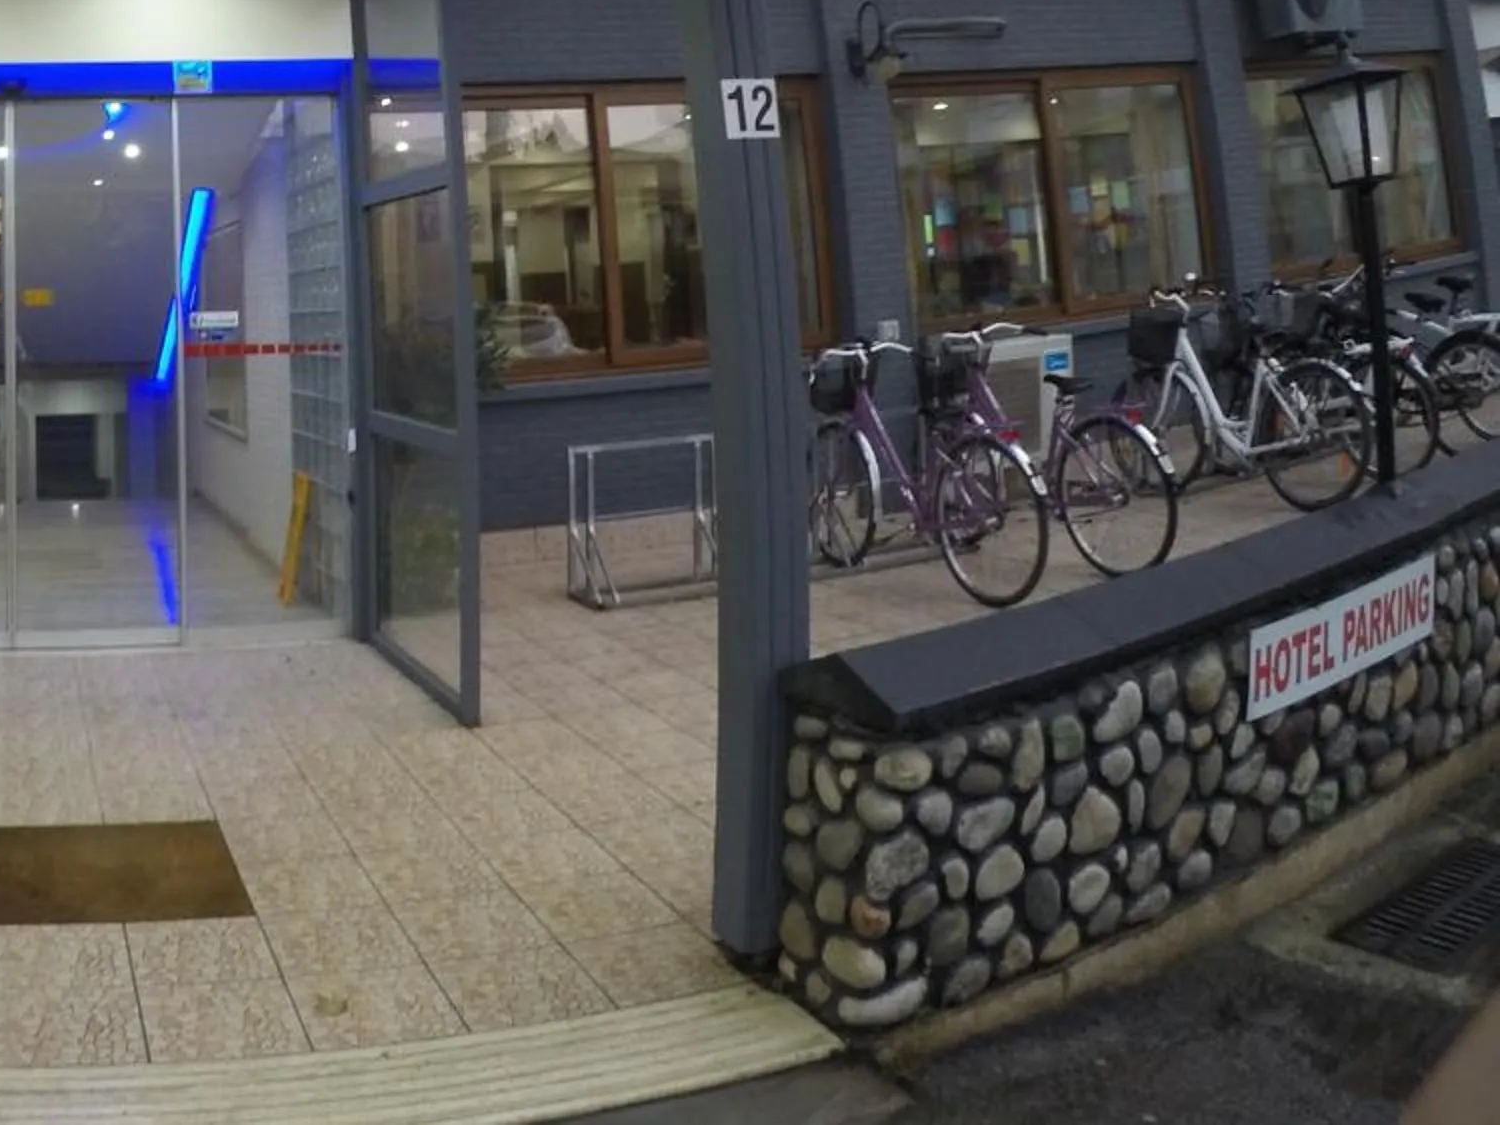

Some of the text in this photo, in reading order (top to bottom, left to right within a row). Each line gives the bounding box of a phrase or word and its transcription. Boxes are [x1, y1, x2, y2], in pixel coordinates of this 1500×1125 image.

[727, 84, 775, 132] 12
[1254, 574, 1431, 702] HOTEL PARKING
